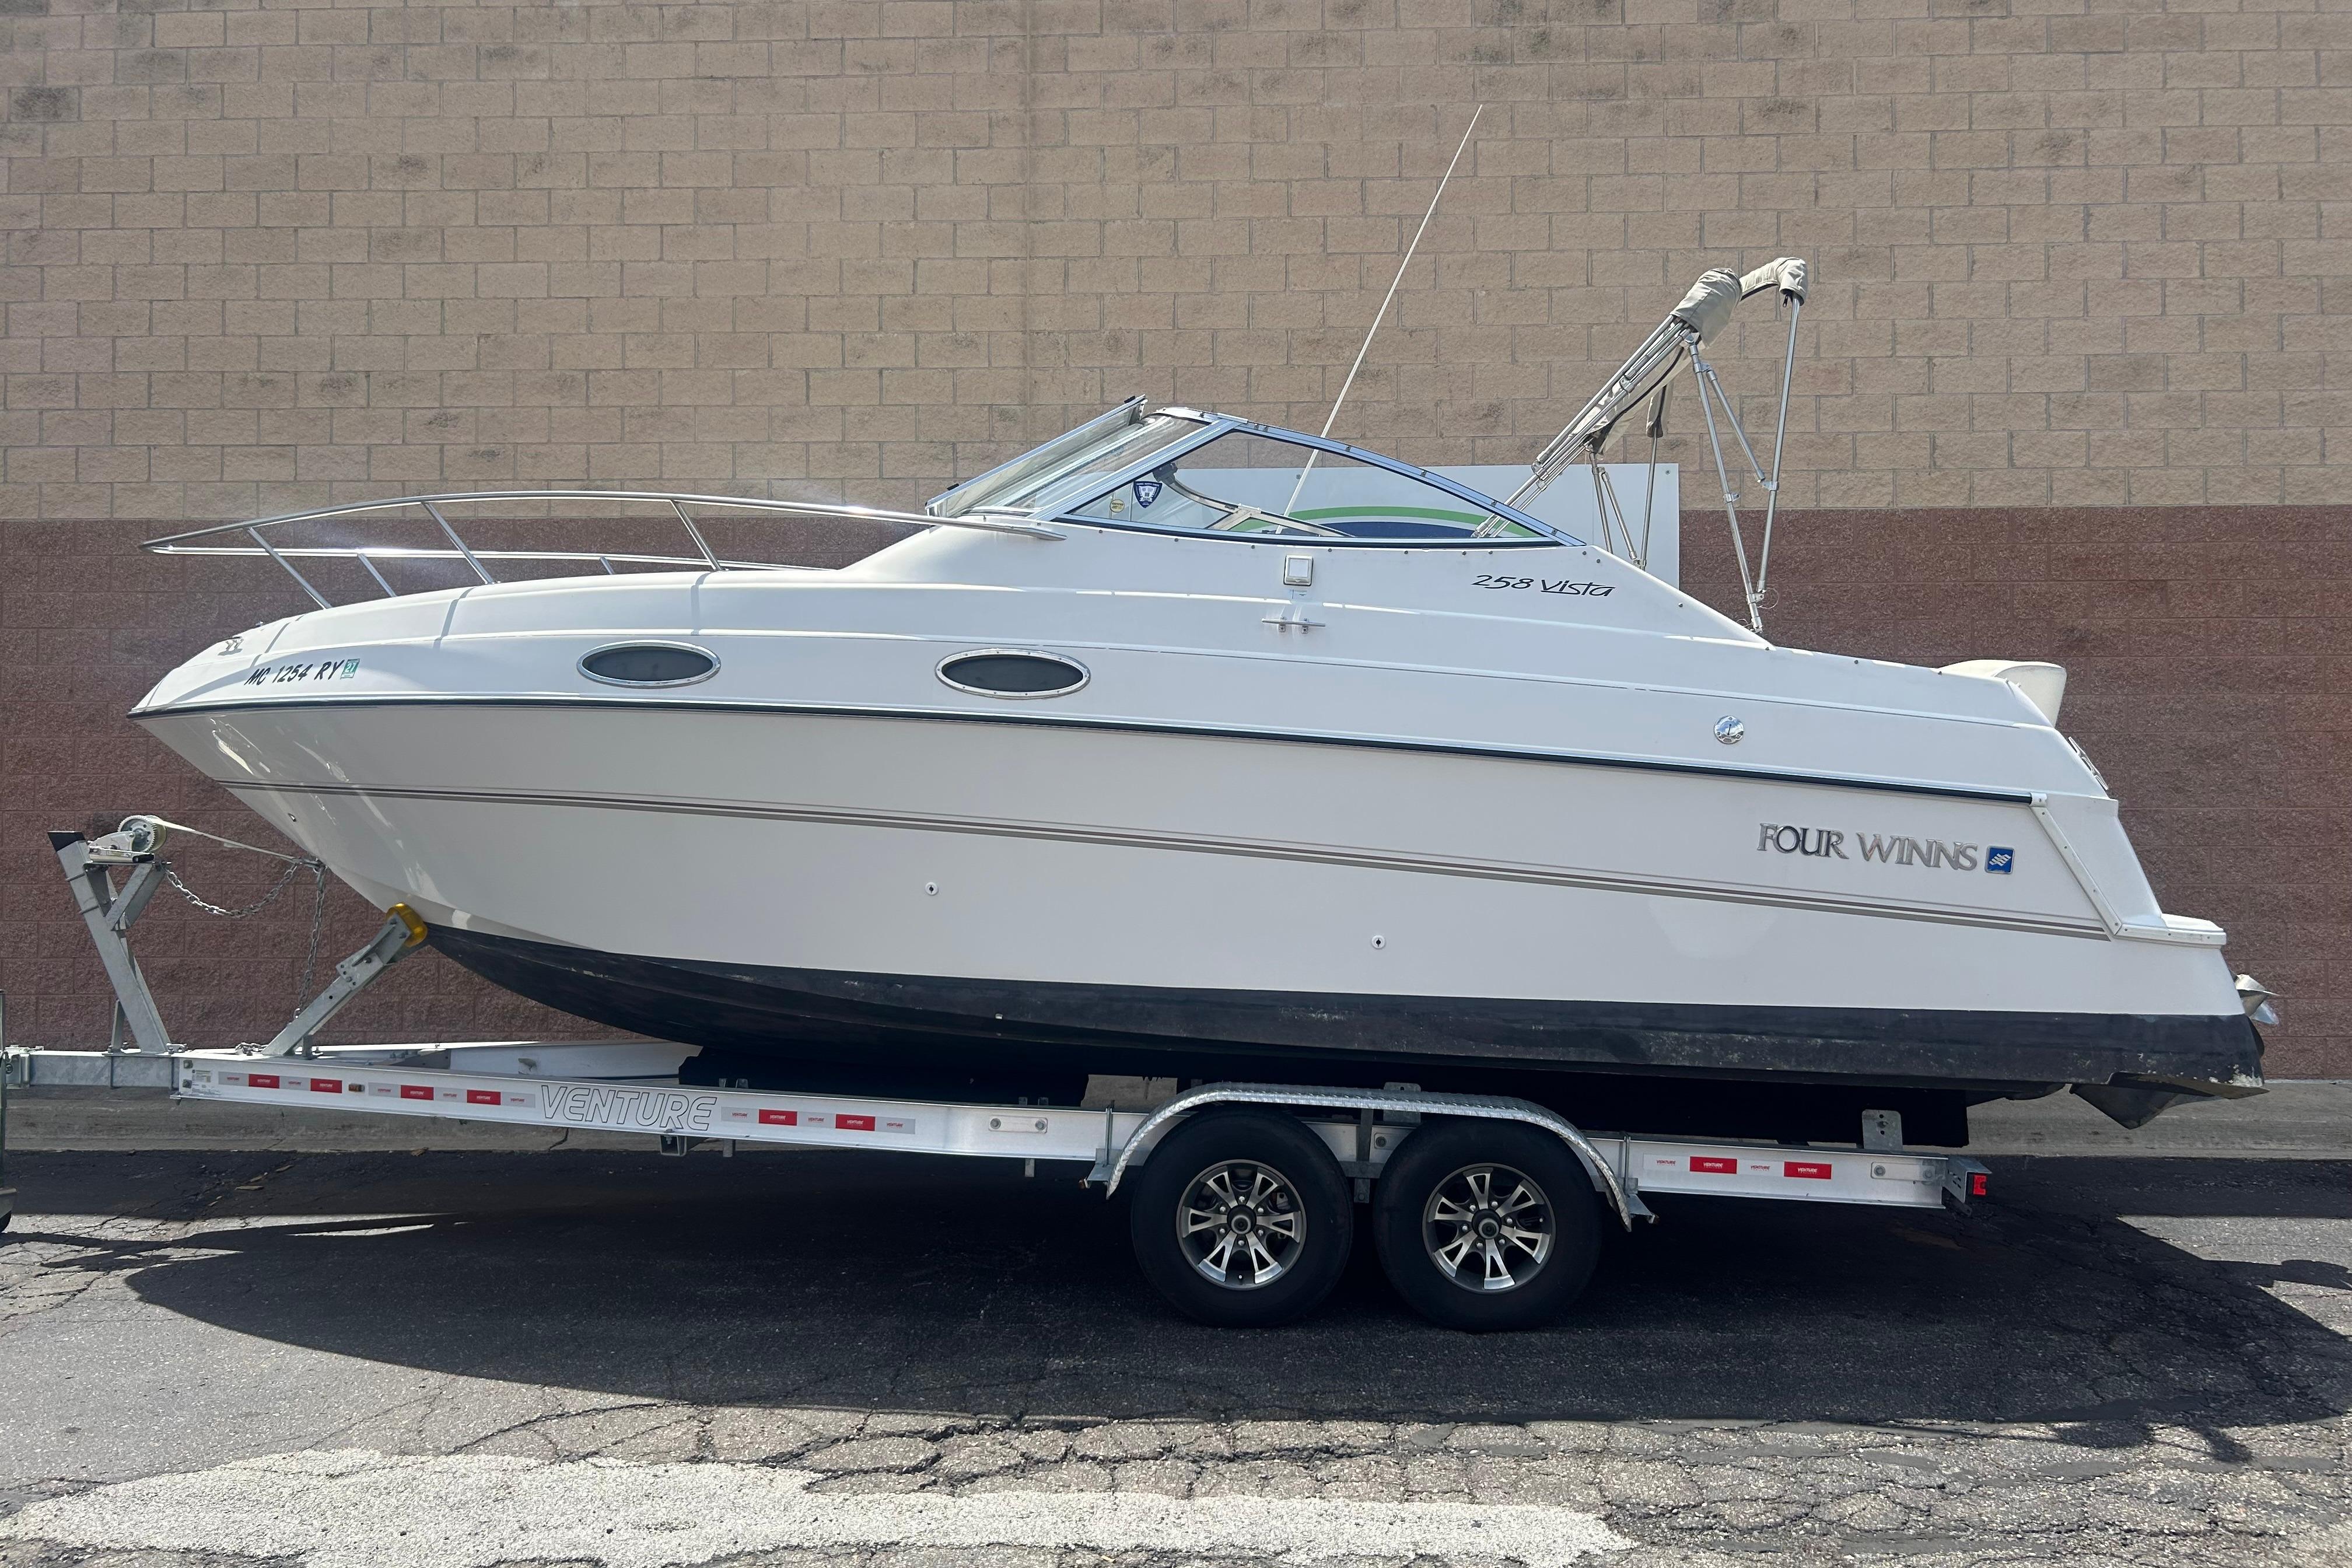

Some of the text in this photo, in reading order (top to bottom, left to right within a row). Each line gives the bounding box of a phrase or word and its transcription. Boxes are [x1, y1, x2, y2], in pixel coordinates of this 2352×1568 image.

[1471, 575, 1534, 589] 258
[244, 659, 345, 686] MC 1254 RY
[1757, 822, 1978, 872] FOUR WINNS
[541, 1084, 718, 1131] VENTURE
